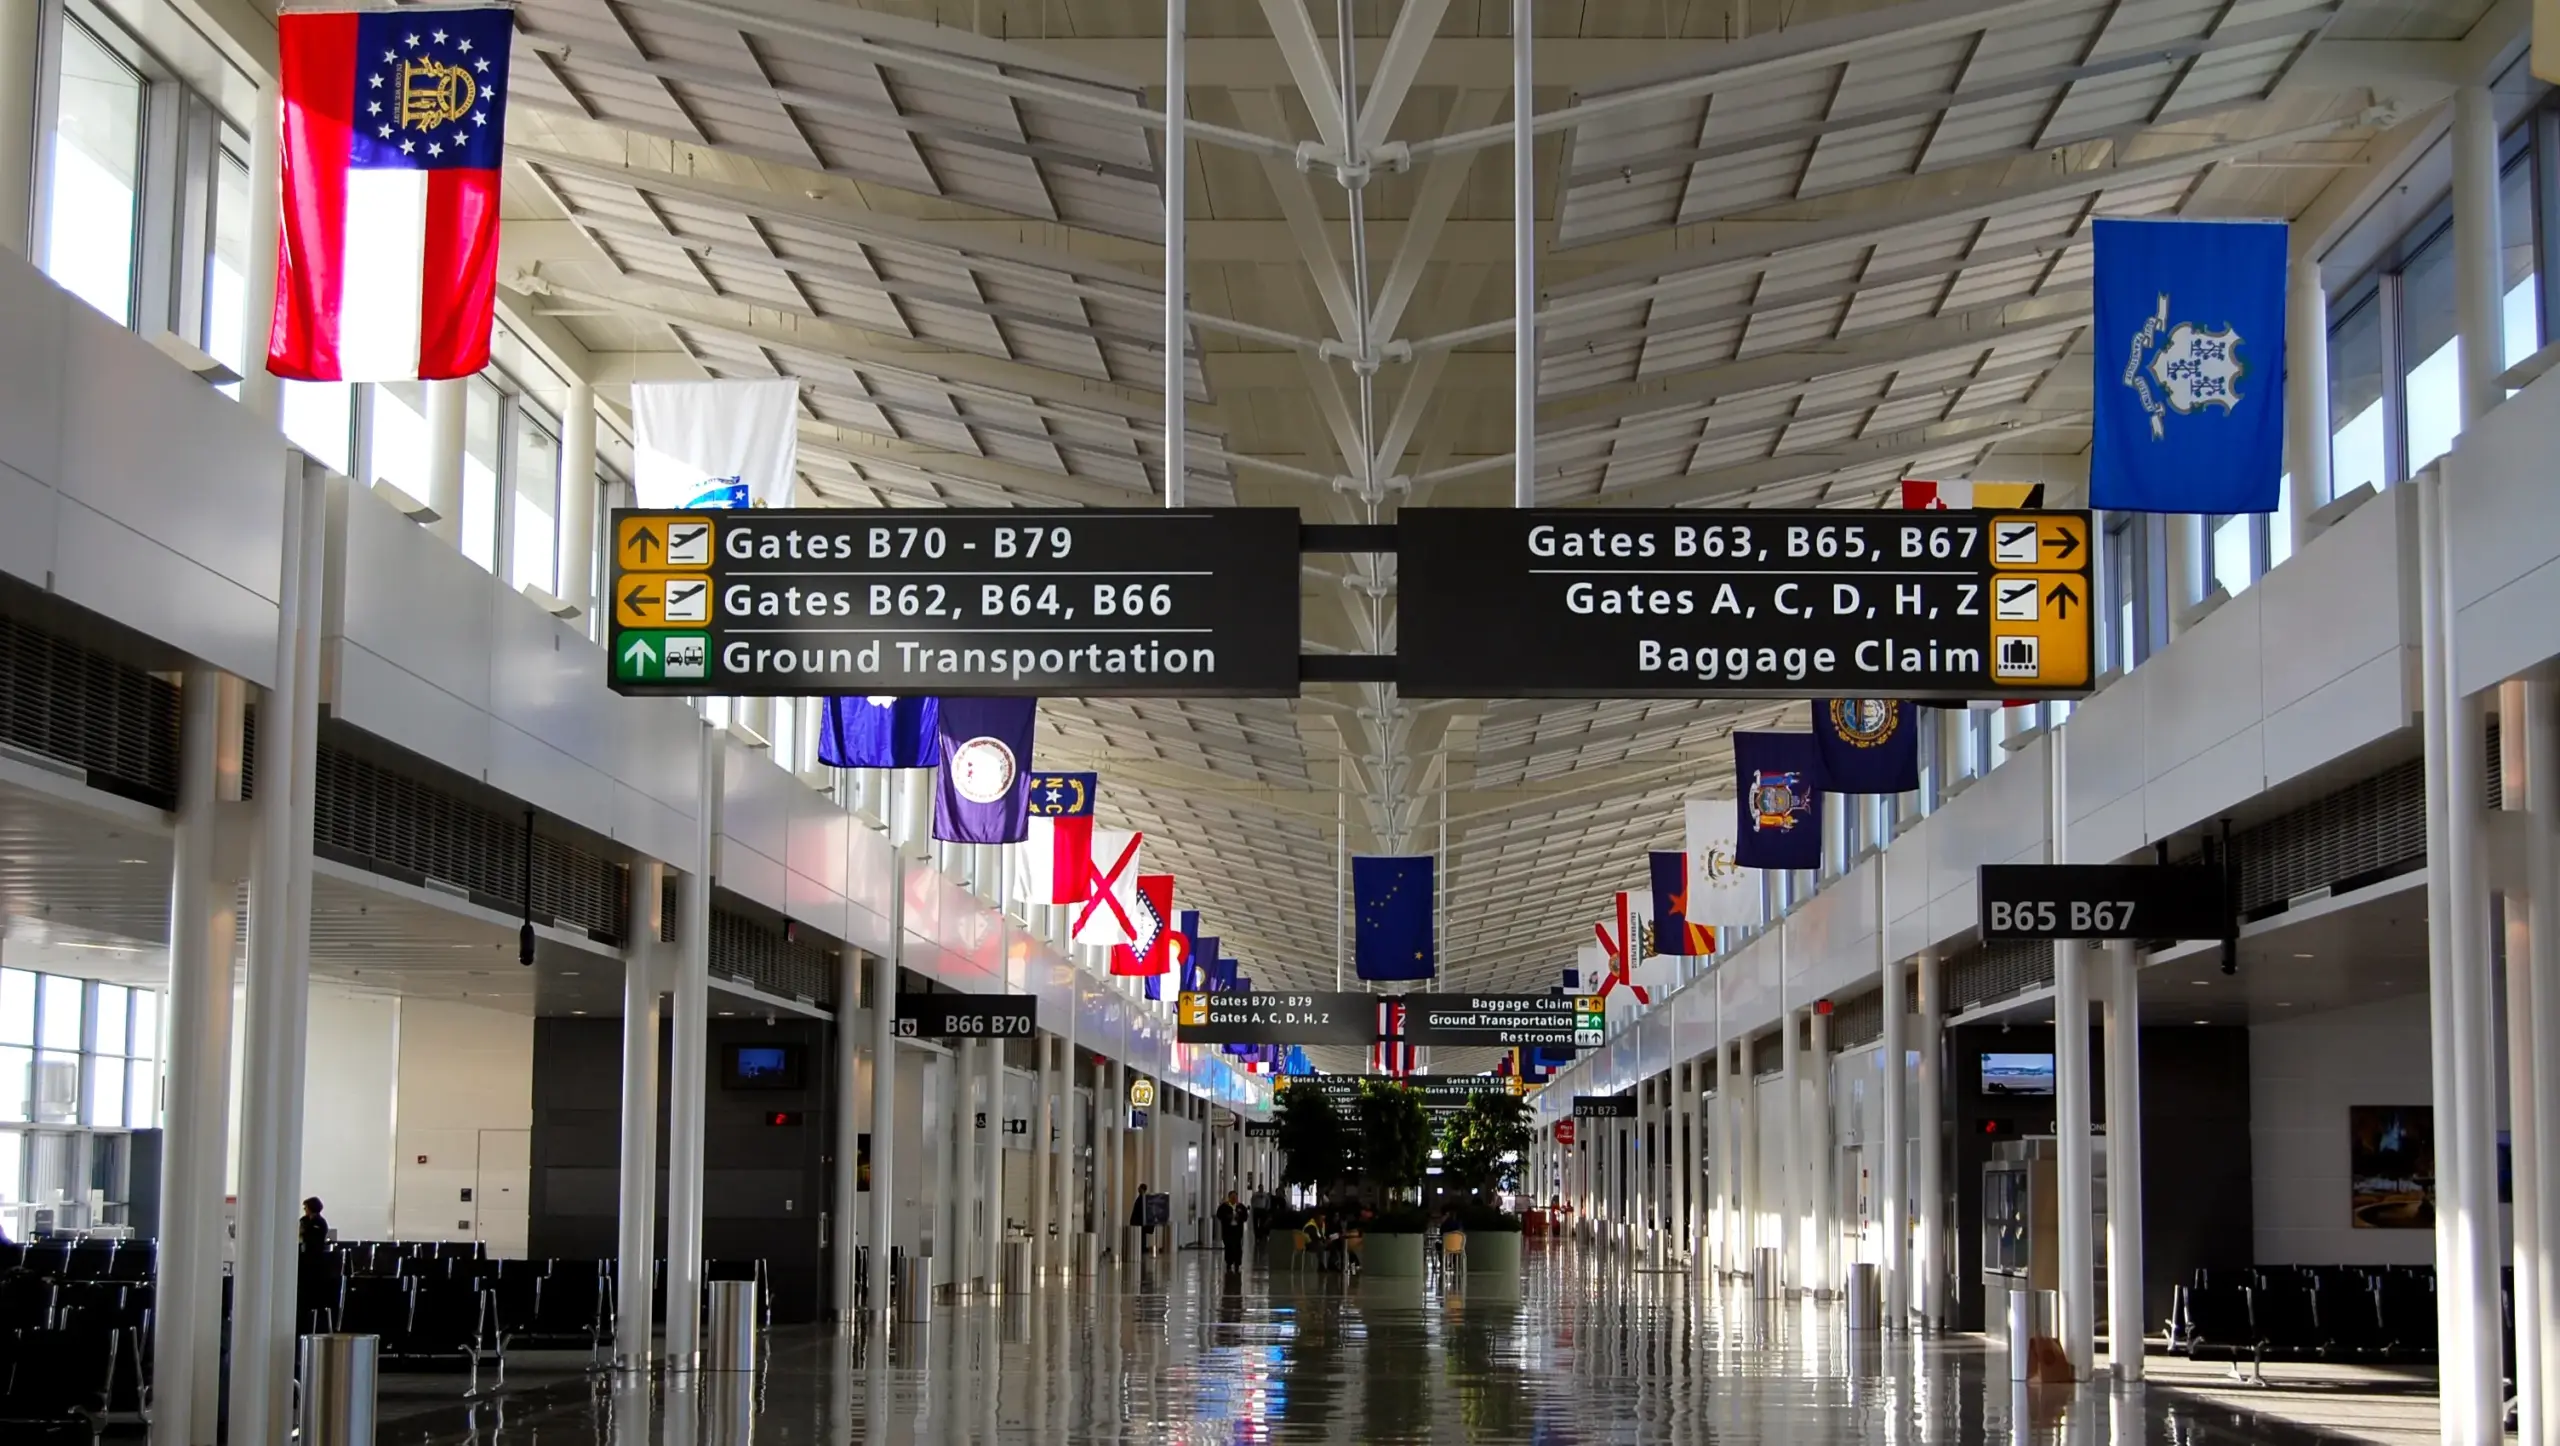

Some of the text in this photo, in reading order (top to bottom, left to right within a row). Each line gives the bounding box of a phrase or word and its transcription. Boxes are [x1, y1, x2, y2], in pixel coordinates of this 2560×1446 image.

[726, 528, 851, 559] Gates
[869, 528, 946, 559] B70
[994, 528, 1072, 559] B79
[1528, 526, 1978, 562] Gates B63, B65, B67
[725, 584, 1172, 620] Gates B62, B64, B66
[1566, 582, 1979, 620] Gates A, C, D, H, Z
[724, 640, 1215, 681] Ground Transportation
[1639, 639, 1979, 680] Baggage Claim
[1045, 777, 1063, 814] N C
[1991, 901, 2135, 931] B65 B67
[1210, 995, 1248, 1007] Gates
[1252, 996, 1276, 1007] B70
[1288, 996, 1312, 1007] B79
[1472, 998, 1573, 1011] Baggage Claim
[945, 1015, 1031, 1034] B66 B70
[1210, 1012, 1329, 1025] Gates A, C, D, H, Z
[1429, 1014, 1573, 1027] Ground Transportation
[1500, 1031, 1573, 1042] Restrooms
[1328, 1085, 1351, 1093] Claim
[1446, 1077, 1469, 1085] Gates
[1575, 1106, 1617, 1115] B71 B73
